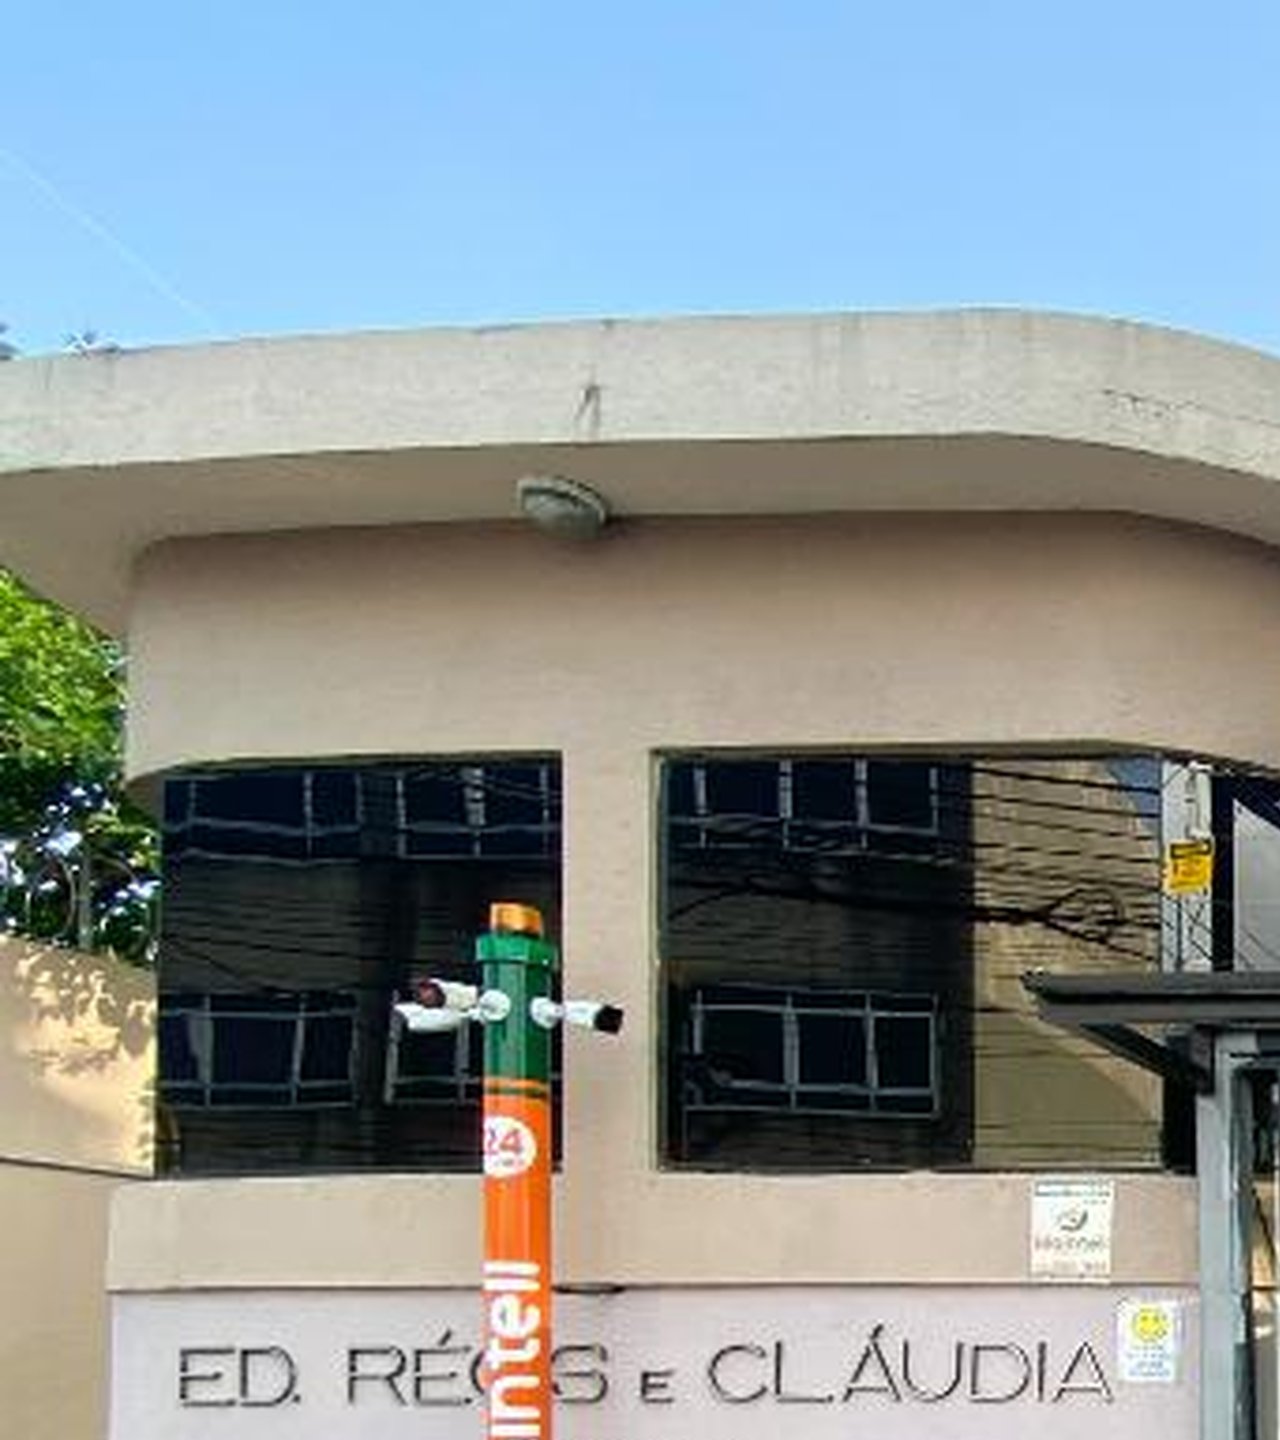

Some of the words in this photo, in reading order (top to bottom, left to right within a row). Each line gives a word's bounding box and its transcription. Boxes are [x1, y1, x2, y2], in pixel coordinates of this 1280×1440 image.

[179, 1346, 300, 1407] ED.
[348, 1328, 608, 1405] RÉS
[707, 1324, 1115, 1404] CLÁUDIA
